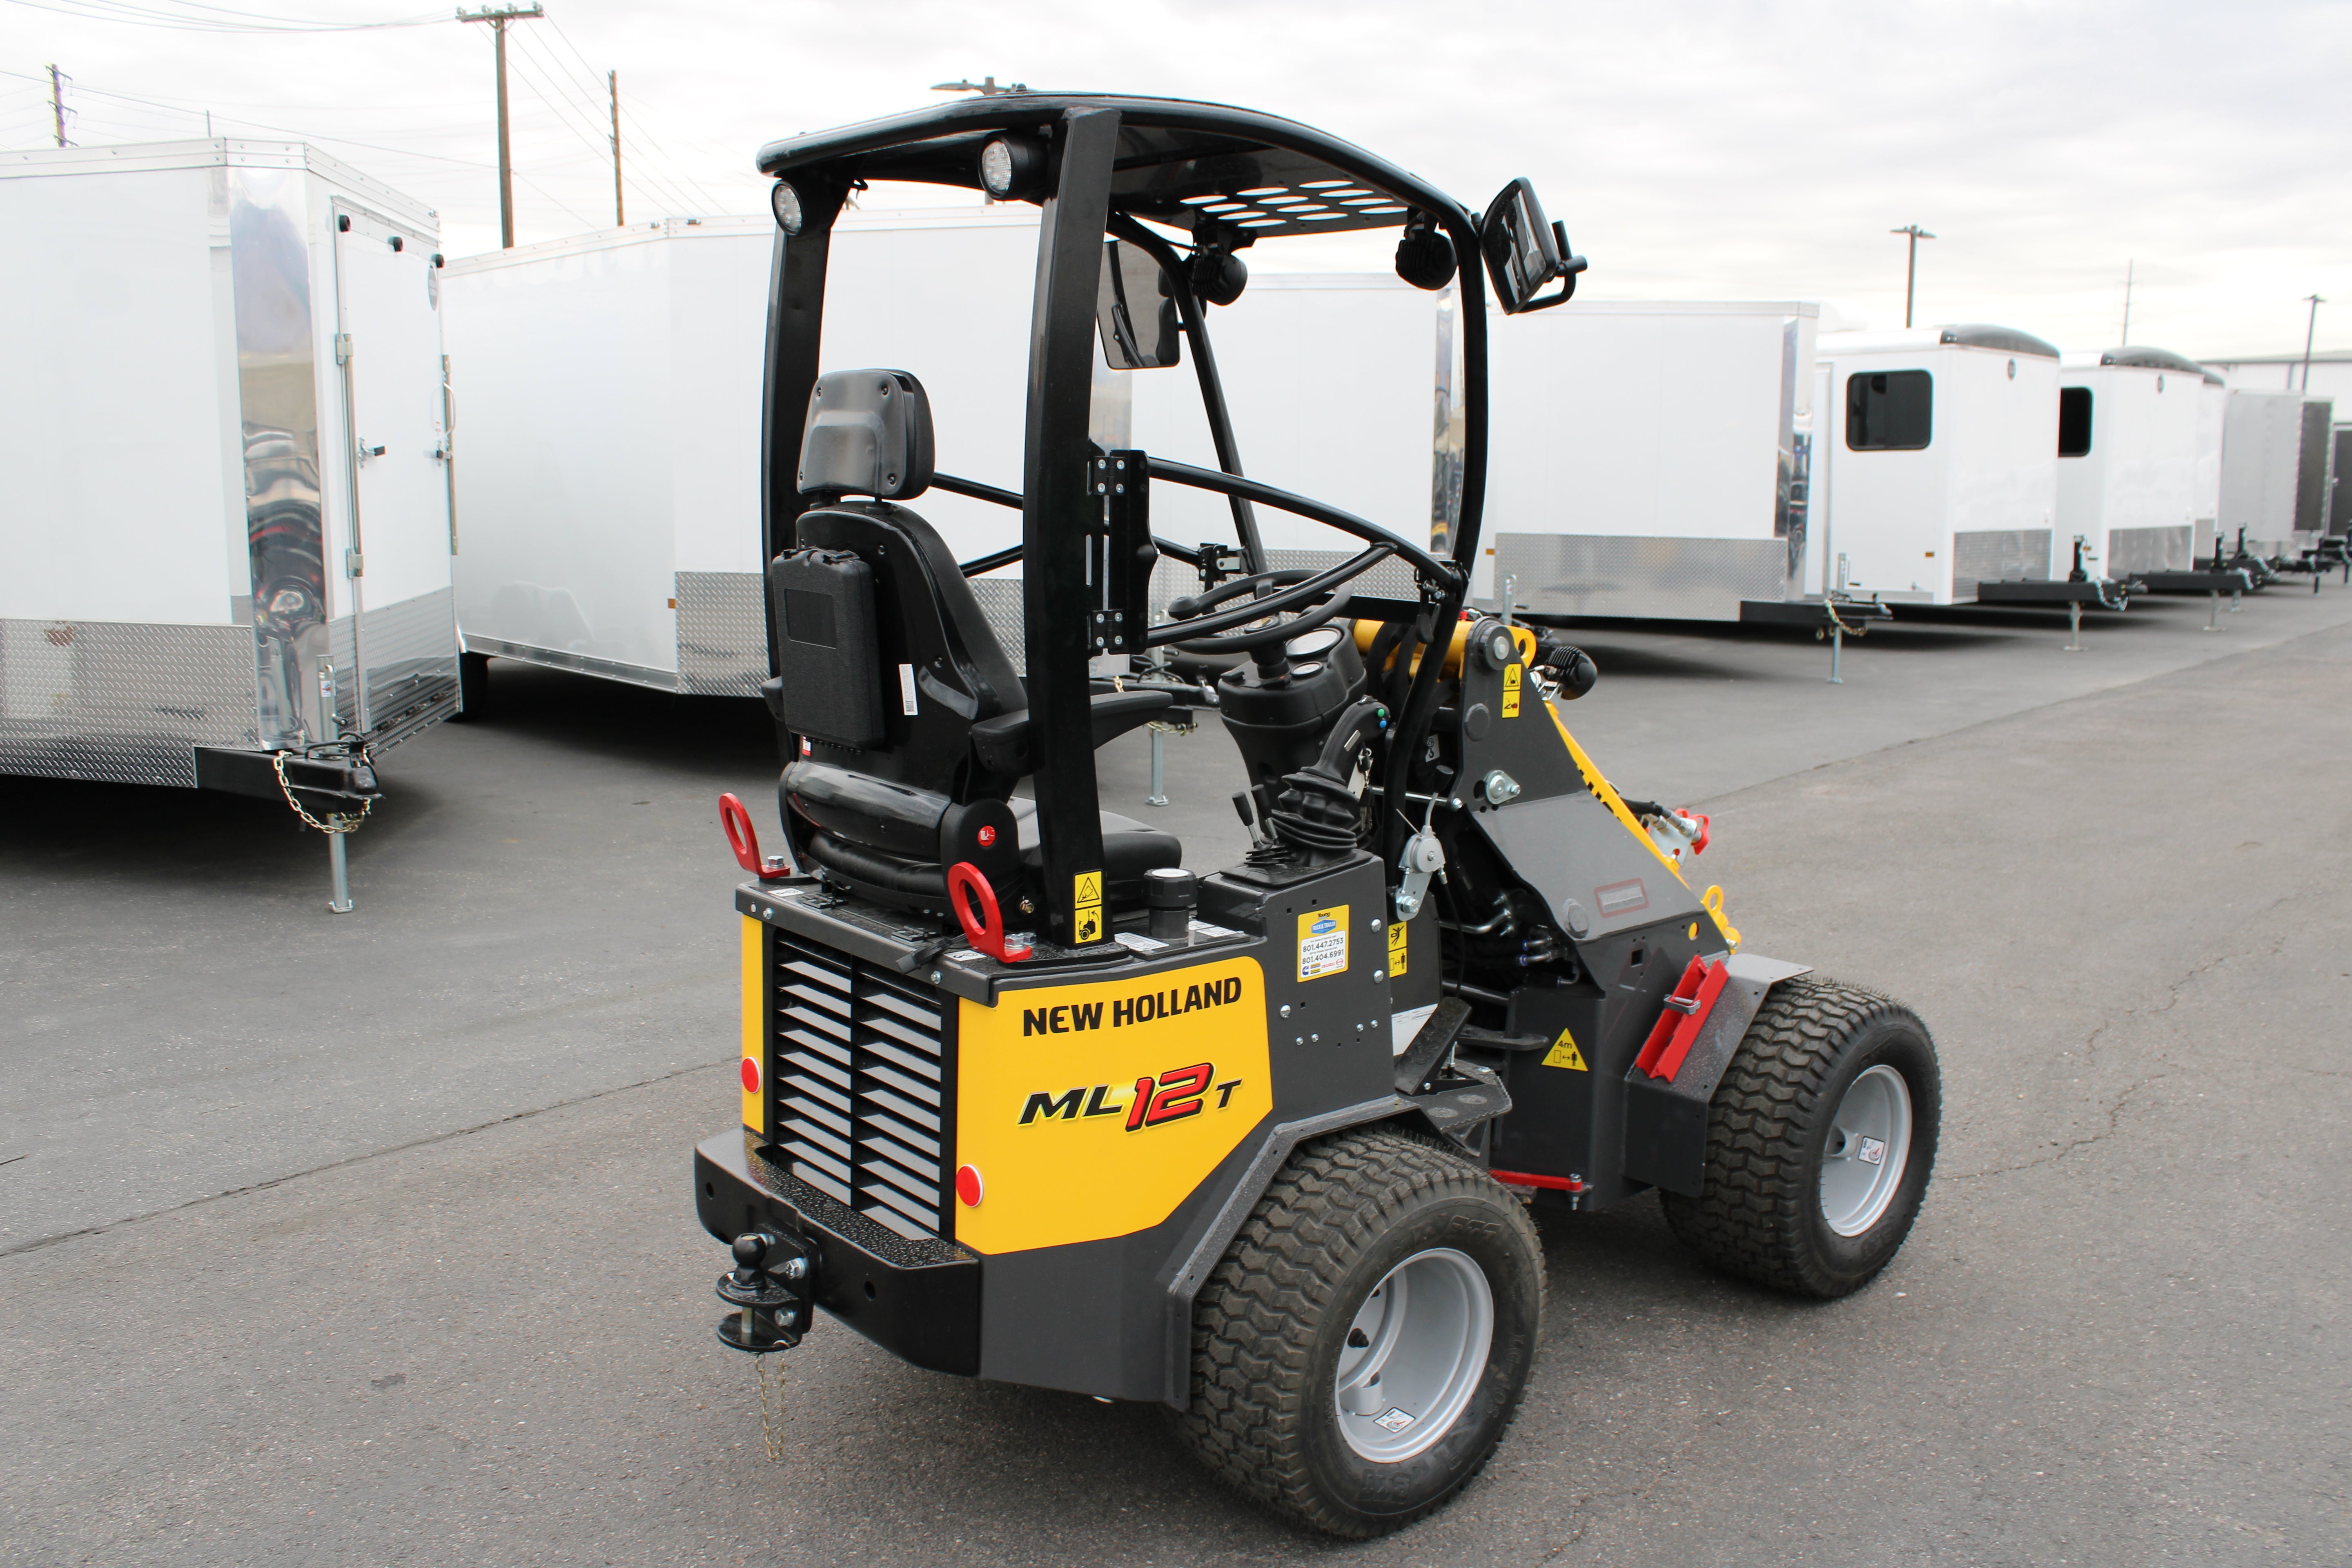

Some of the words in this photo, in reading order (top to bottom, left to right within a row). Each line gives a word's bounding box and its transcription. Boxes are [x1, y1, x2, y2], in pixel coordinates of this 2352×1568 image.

[1303, 937, 1344, 952] 801.447.2753
[1302, 949, 1344, 964] 801.404.6991
[1023, 1002, 1104, 1037] NEW
[1114, 977, 1242, 1027] HOLLAND
[1558, 1040, 1572, 1049] 4m
